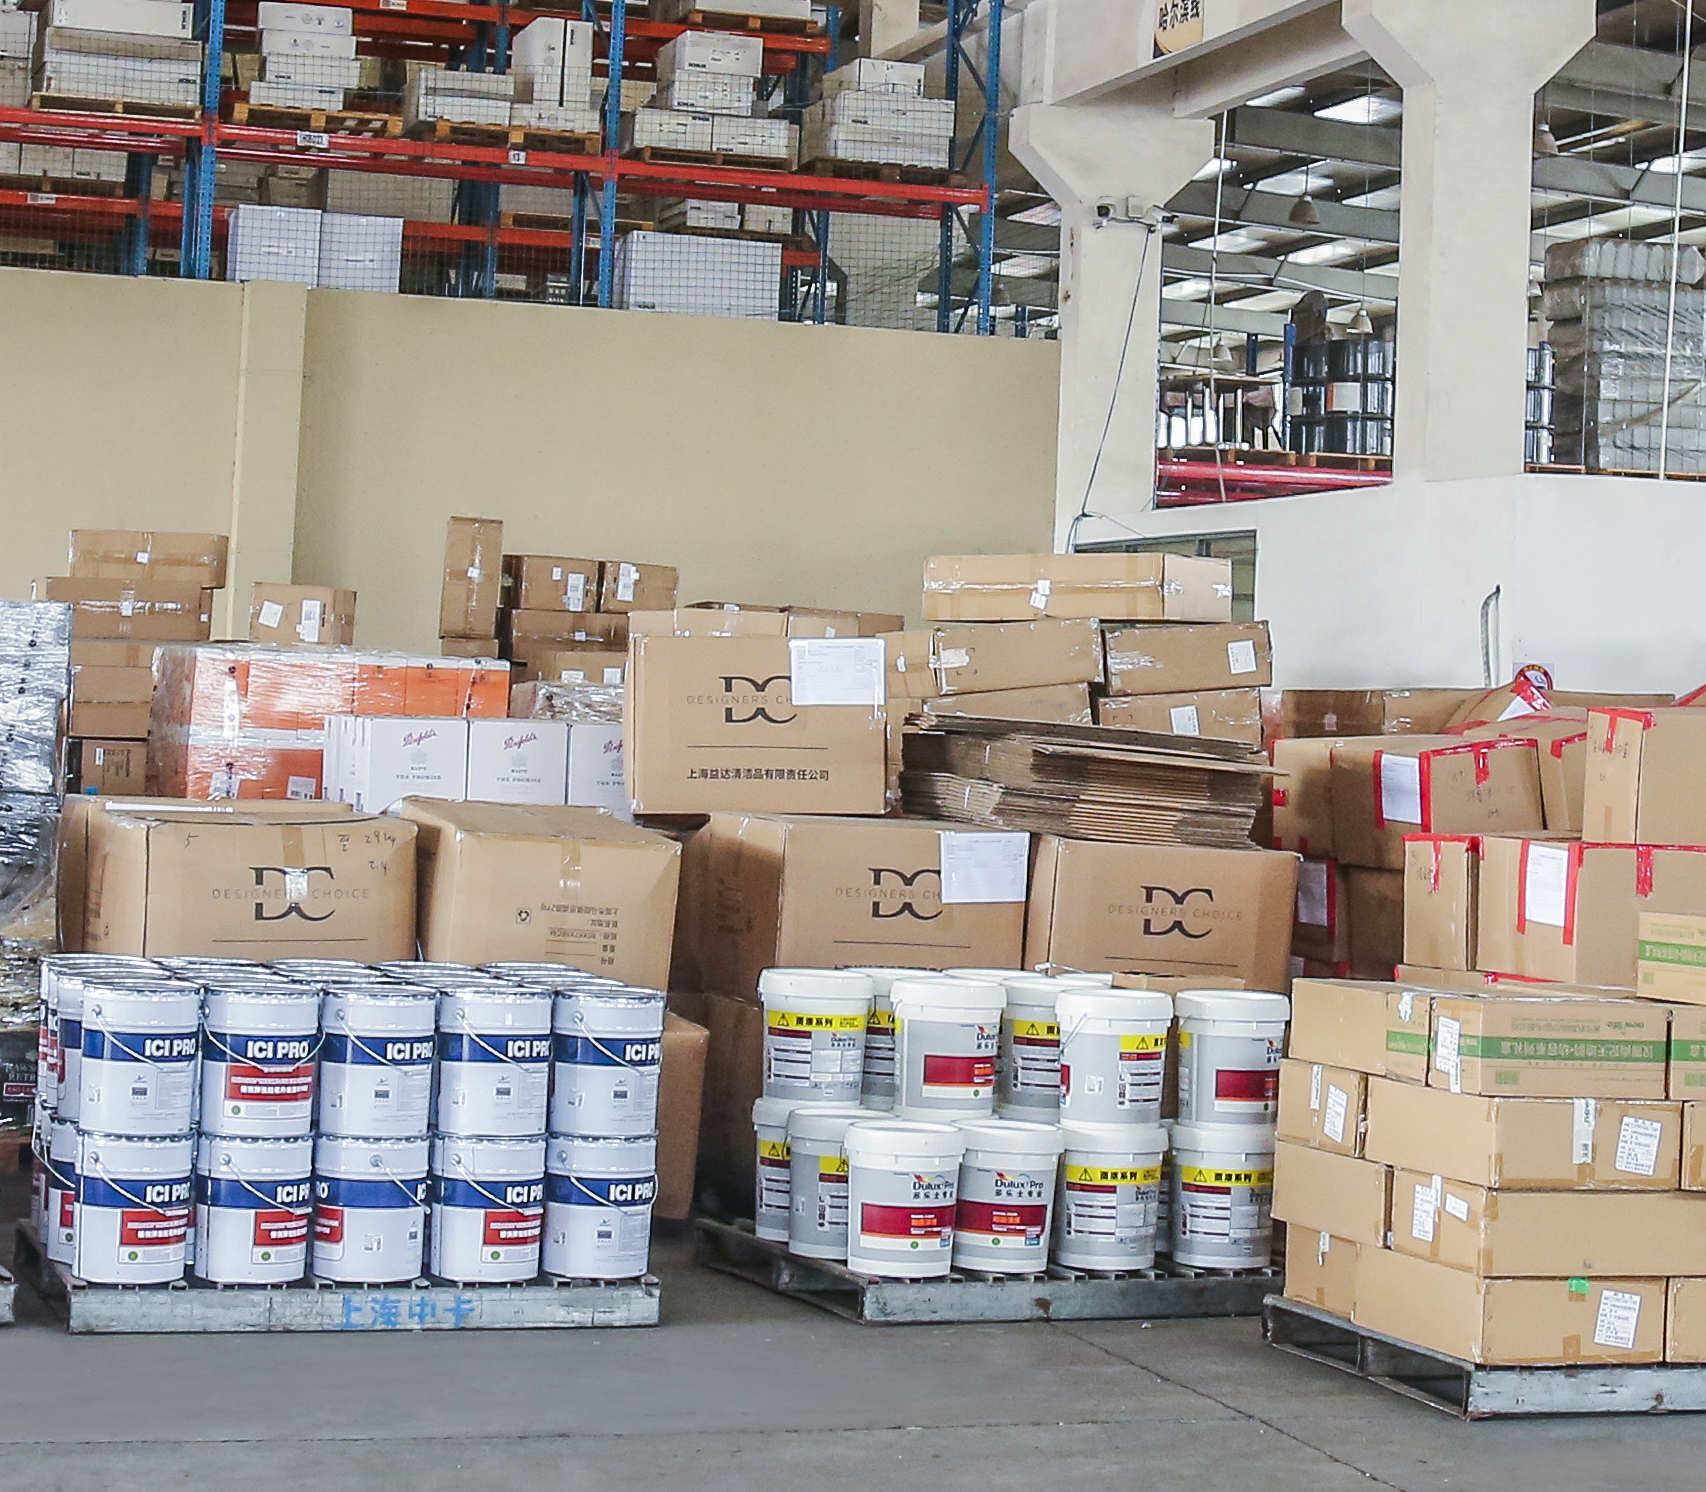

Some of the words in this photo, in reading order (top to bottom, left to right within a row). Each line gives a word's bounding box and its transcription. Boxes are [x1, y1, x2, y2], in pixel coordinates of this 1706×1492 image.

[687, 695, 768, 705] DESIGNERS
[312, 888, 371, 900] CHOICE
[835, 887, 915, 900] DESIGNERS
[1108, 903, 1187, 917] DESIGNERS
[144, 1039, 171, 1056] ICI
[246, 1040, 275, 1058] ICI
[276, 1039, 309, 1058] PRO
[386, 1042, 410, 1060] ICI
[507, 1040, 530, 1058] ICI
[625, 1043, 646, 1061] ICI
[609, 1183, 632, 1201] ICI
[913, 1182, 942, 1191] Dulux
[995, 1179, 1024, 1189] Dulux
[1030, 1181, 1044, 1189] Pro
[145, 1185, 170, 1203] ICI
[276, 1185, 296, 1203] ICI
[505, 1185, 528, 1203] ICI
[333, 1294, 476, 1330] 上海中卡
